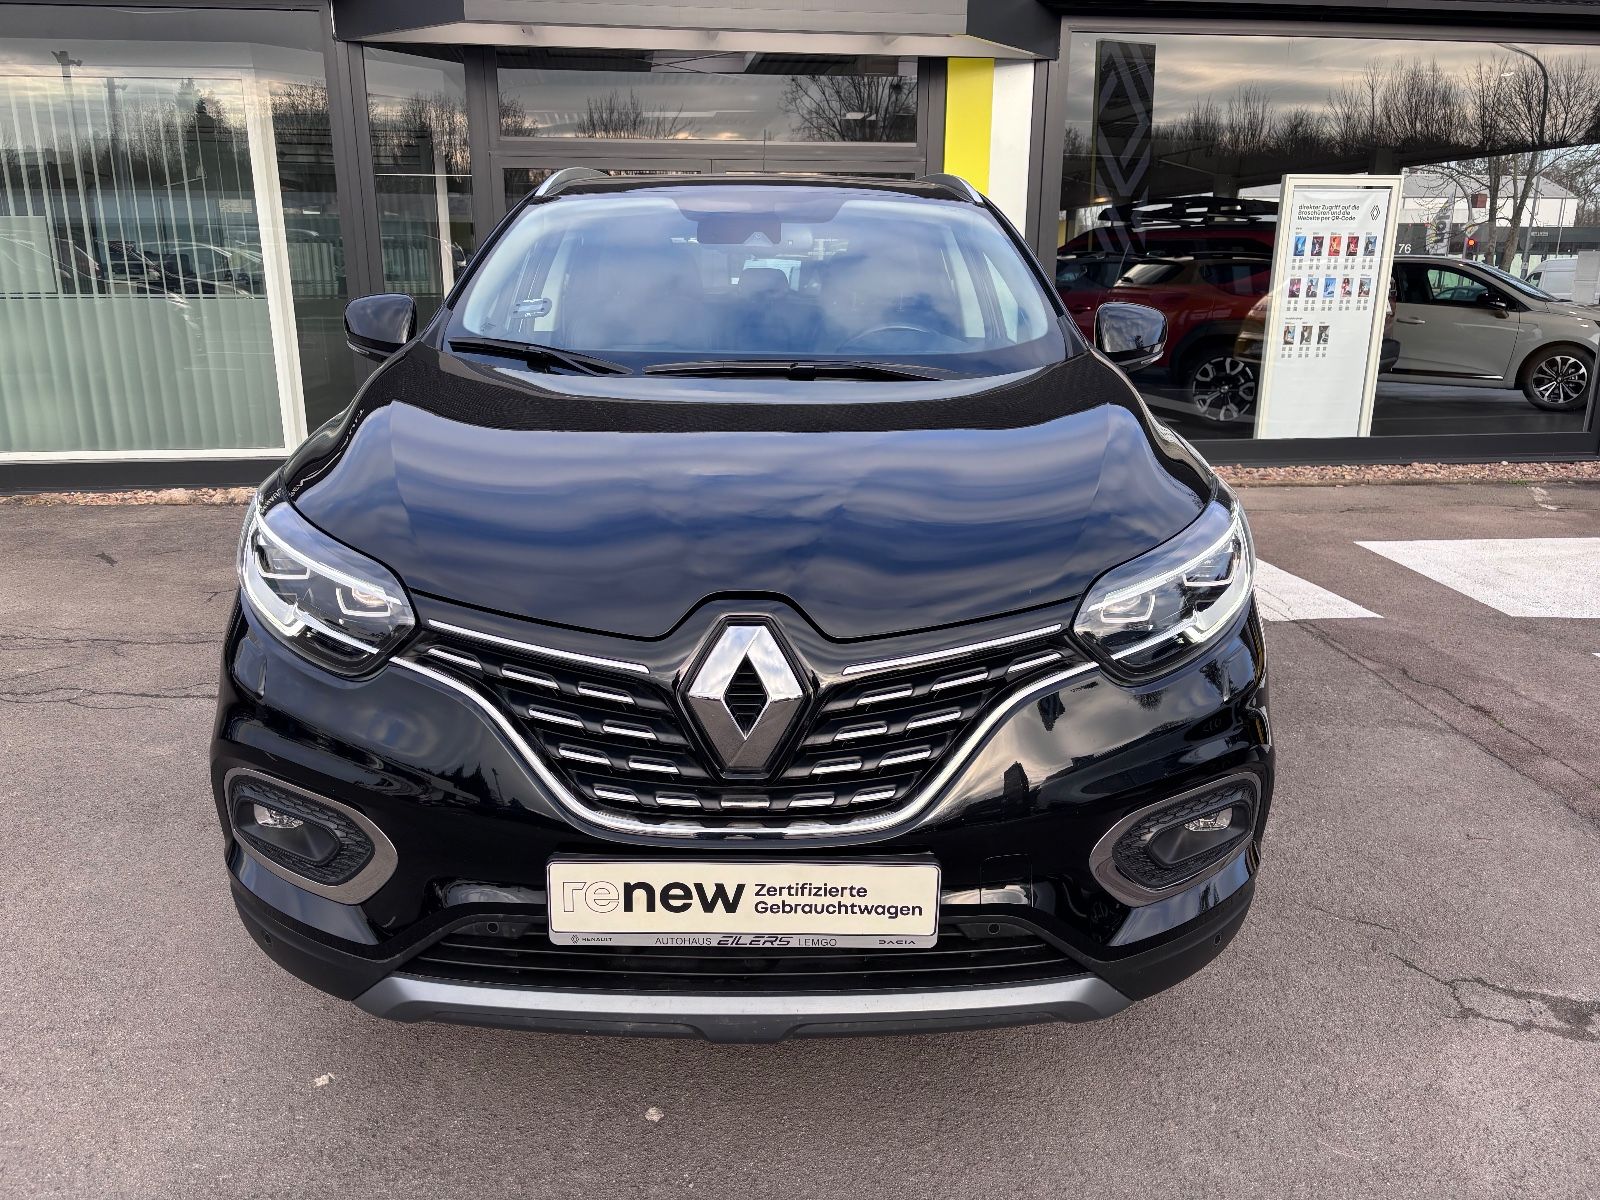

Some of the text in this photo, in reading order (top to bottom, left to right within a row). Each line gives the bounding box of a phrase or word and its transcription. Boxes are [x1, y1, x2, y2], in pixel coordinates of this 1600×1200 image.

[1398, 243, 1411, 254] 76
[562, 880, 747, 914] renew
[754, 882, 868, 898] Zertifizierte
[754, 900, 923, 919] Gebrauchtwagen
[655, 935, 838, 947] AUTOHAUS EILERS LEMGO
